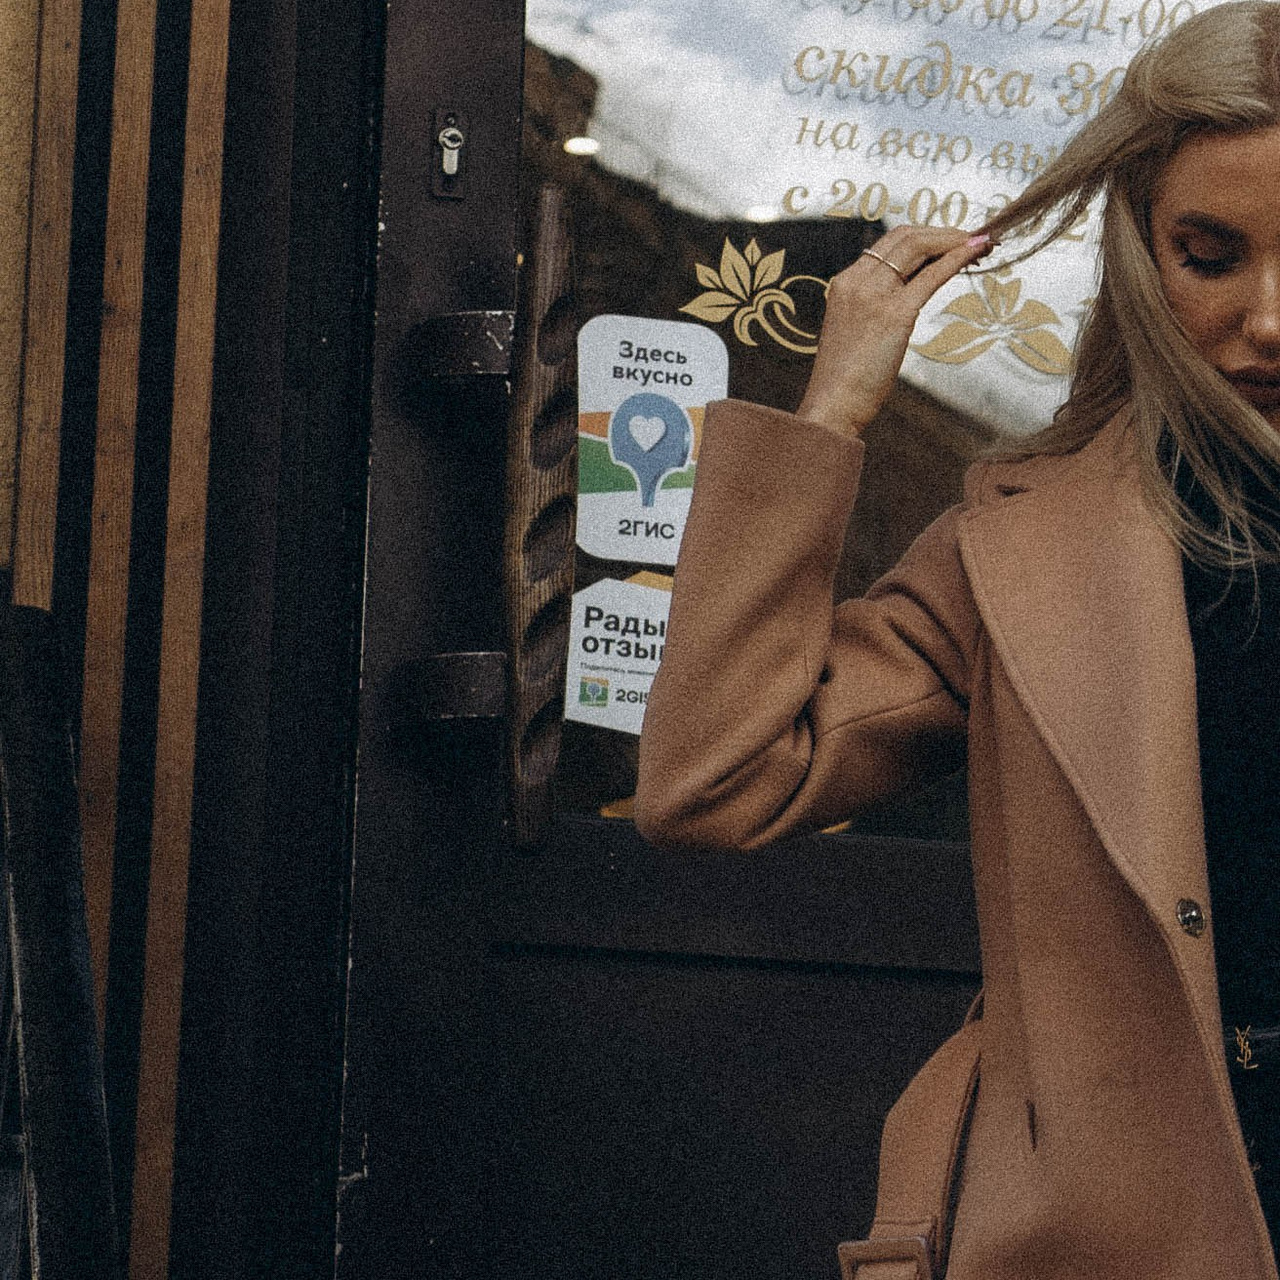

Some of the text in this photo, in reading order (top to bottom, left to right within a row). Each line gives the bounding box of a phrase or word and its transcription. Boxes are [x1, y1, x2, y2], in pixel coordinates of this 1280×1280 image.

[794, 40, 1037, 108] скидка
[796, 117, 861, 151] на
[878, 126, 973, 165] всю
[782, 185, 810, 215] с
[824, 178, 969, 228] 20-00
[618, 339, 689, 366] Здесь
[611, 364, 694, 388] вкусно
[617, 518, 676, 540] 2ГИС
[583, 605, 667, 639] Рады
